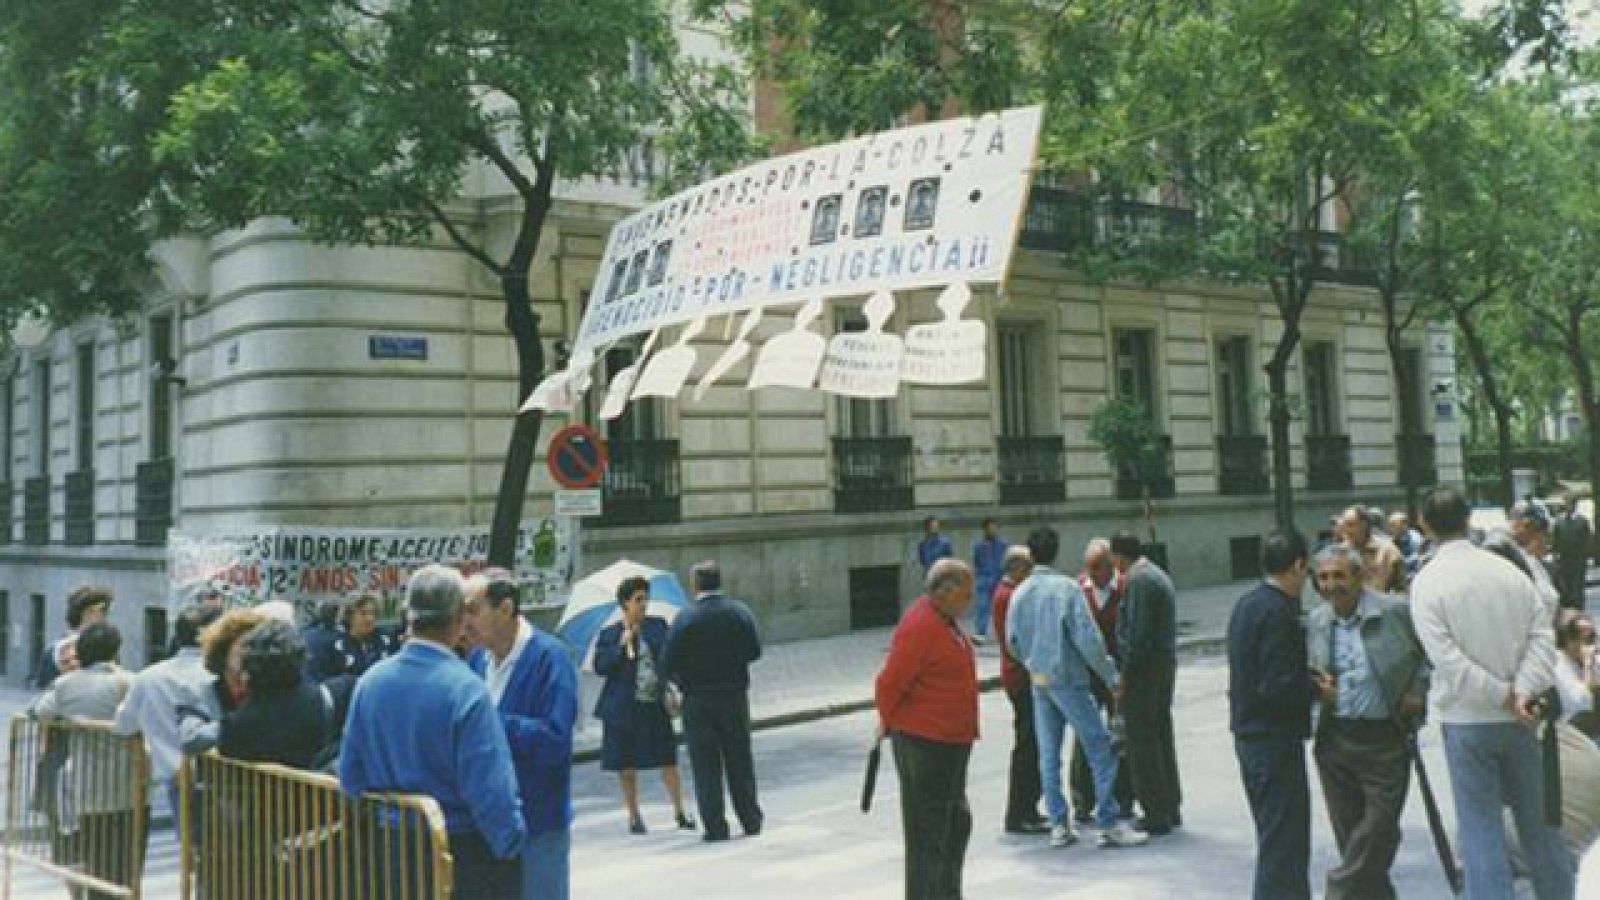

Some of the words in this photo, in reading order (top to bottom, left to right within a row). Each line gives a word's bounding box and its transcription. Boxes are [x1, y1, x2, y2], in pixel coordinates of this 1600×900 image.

[763, 159, 815, 196] POR
[829, 149, 866, 181] LA
[888, 124, 1005, 170] COLZA
